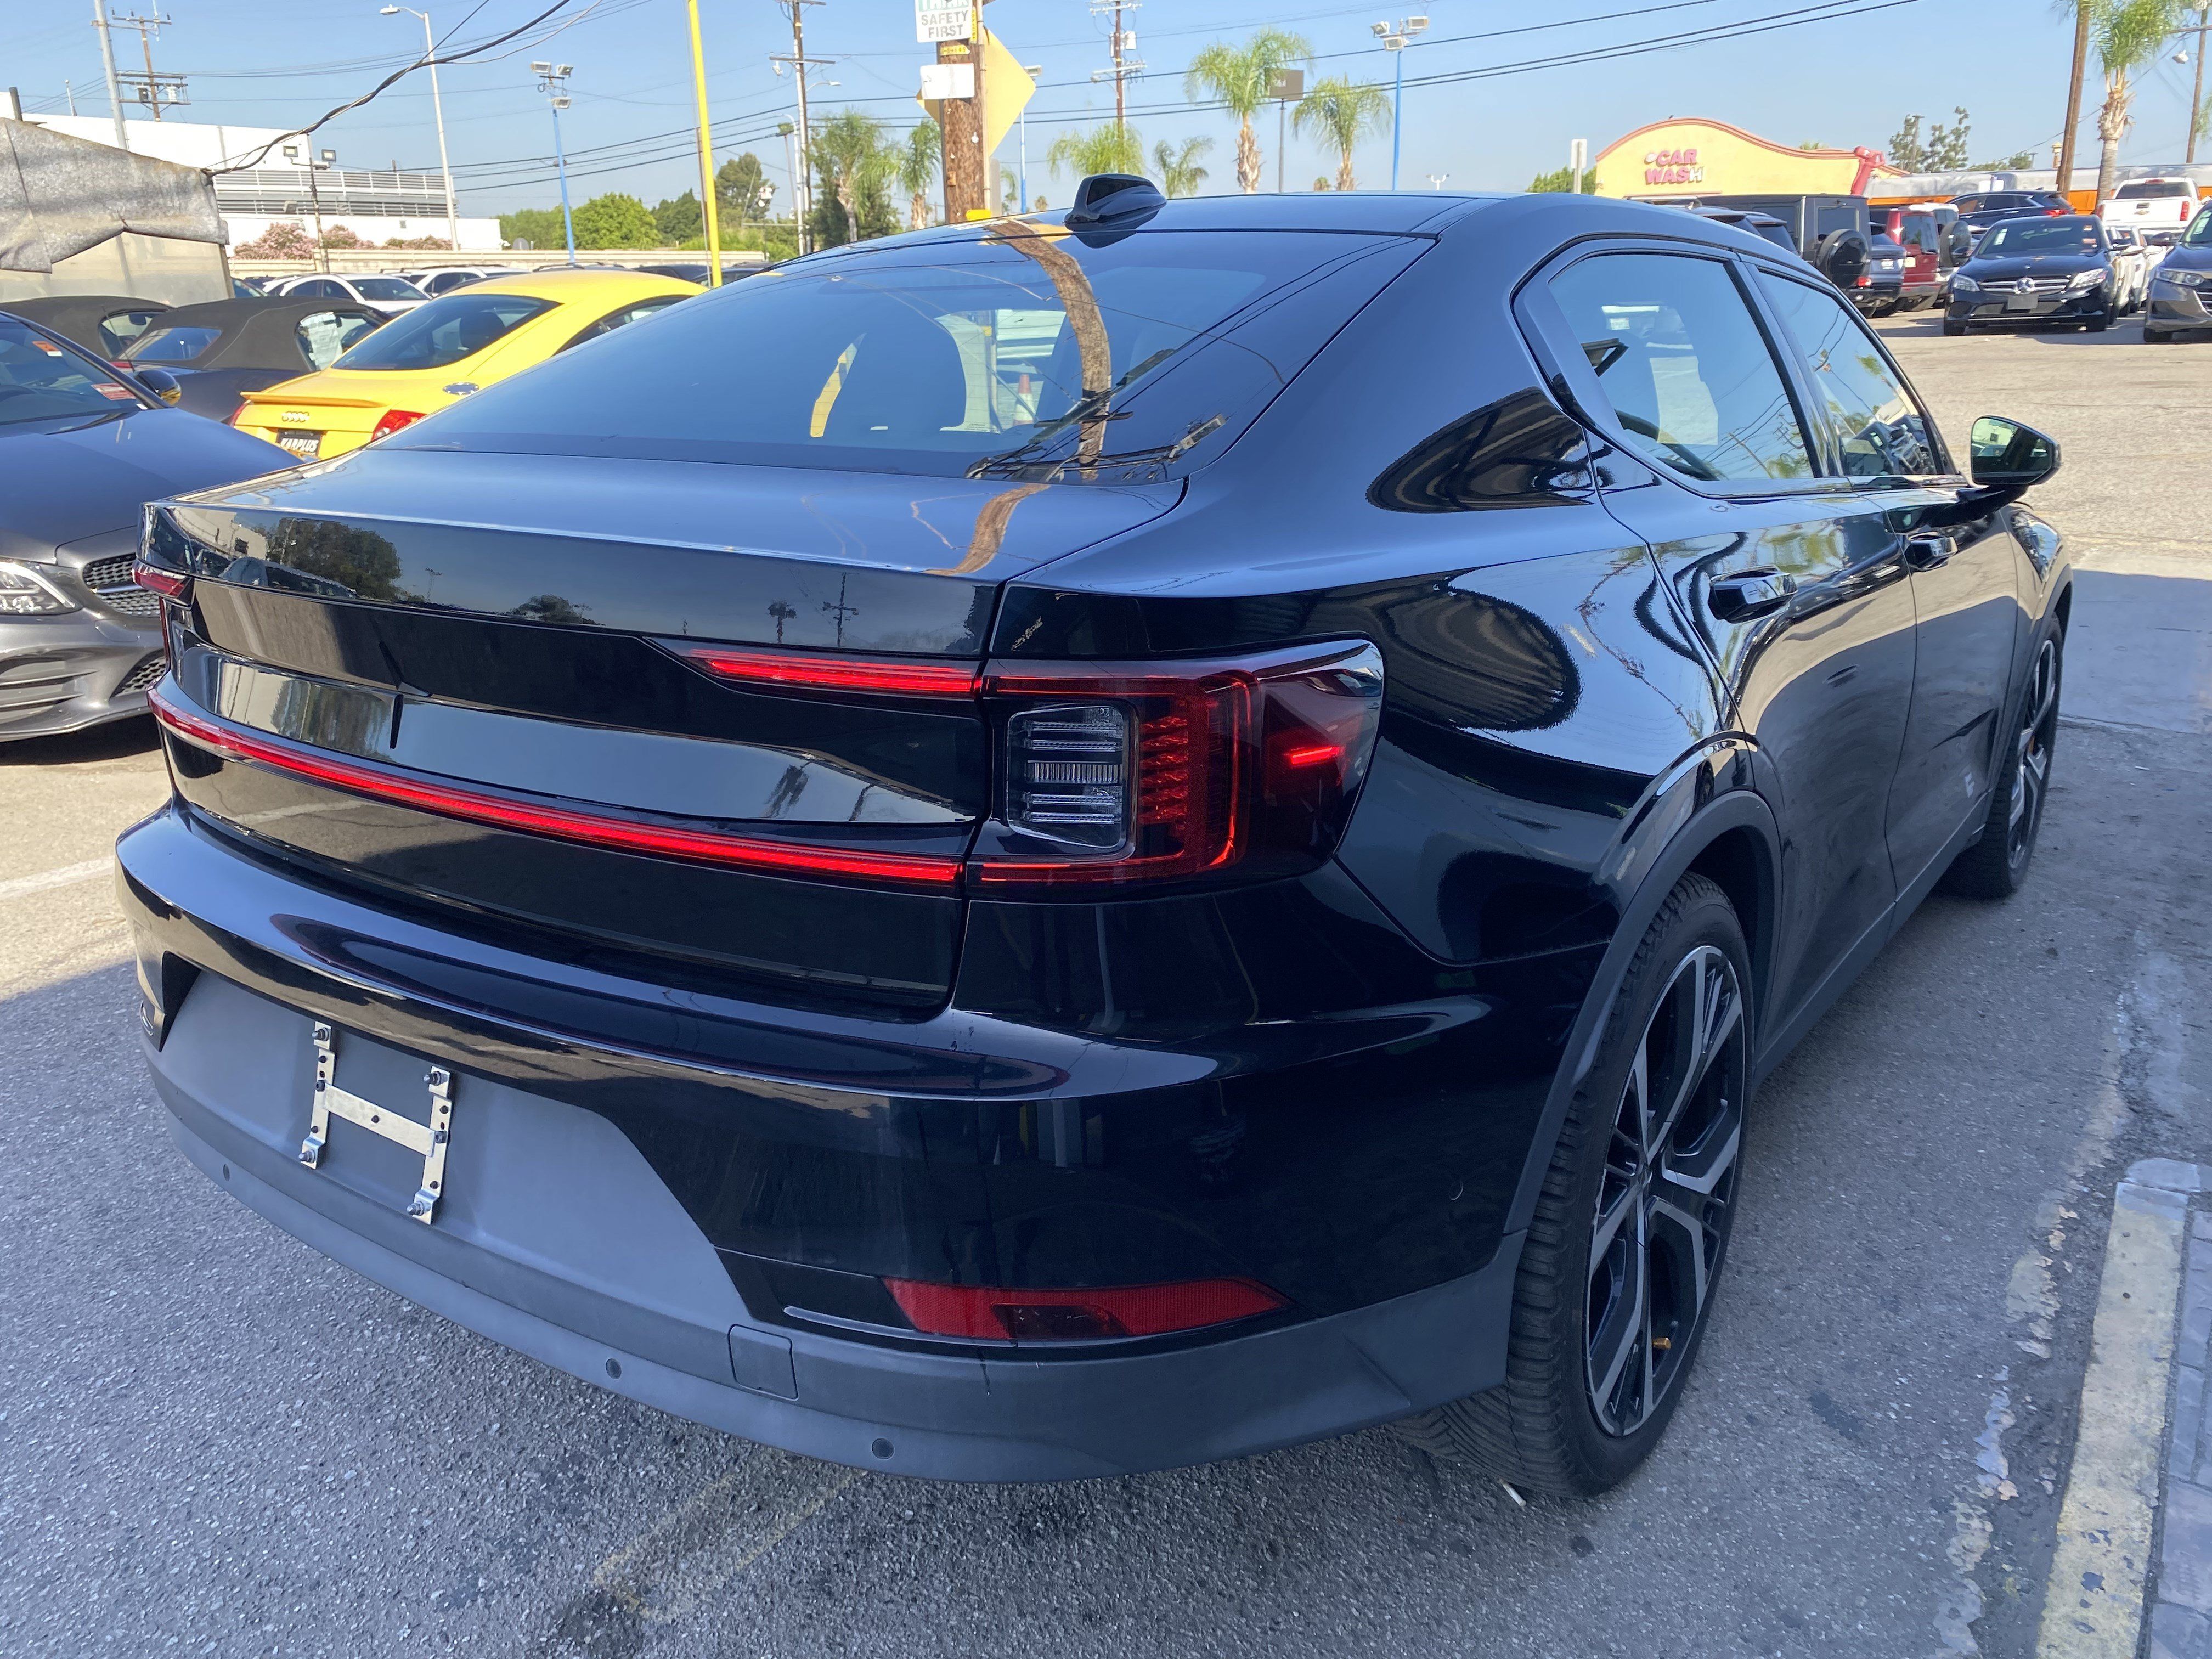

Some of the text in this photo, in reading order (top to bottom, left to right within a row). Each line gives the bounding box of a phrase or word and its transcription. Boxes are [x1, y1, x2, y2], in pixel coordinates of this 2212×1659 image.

[921, 10, 968, 26] SAFETY
[928, 24, 963, 38] FIRST
[1656, 149, 1697, 167] CAR
[1645, 167, 1703, 185] WASH
